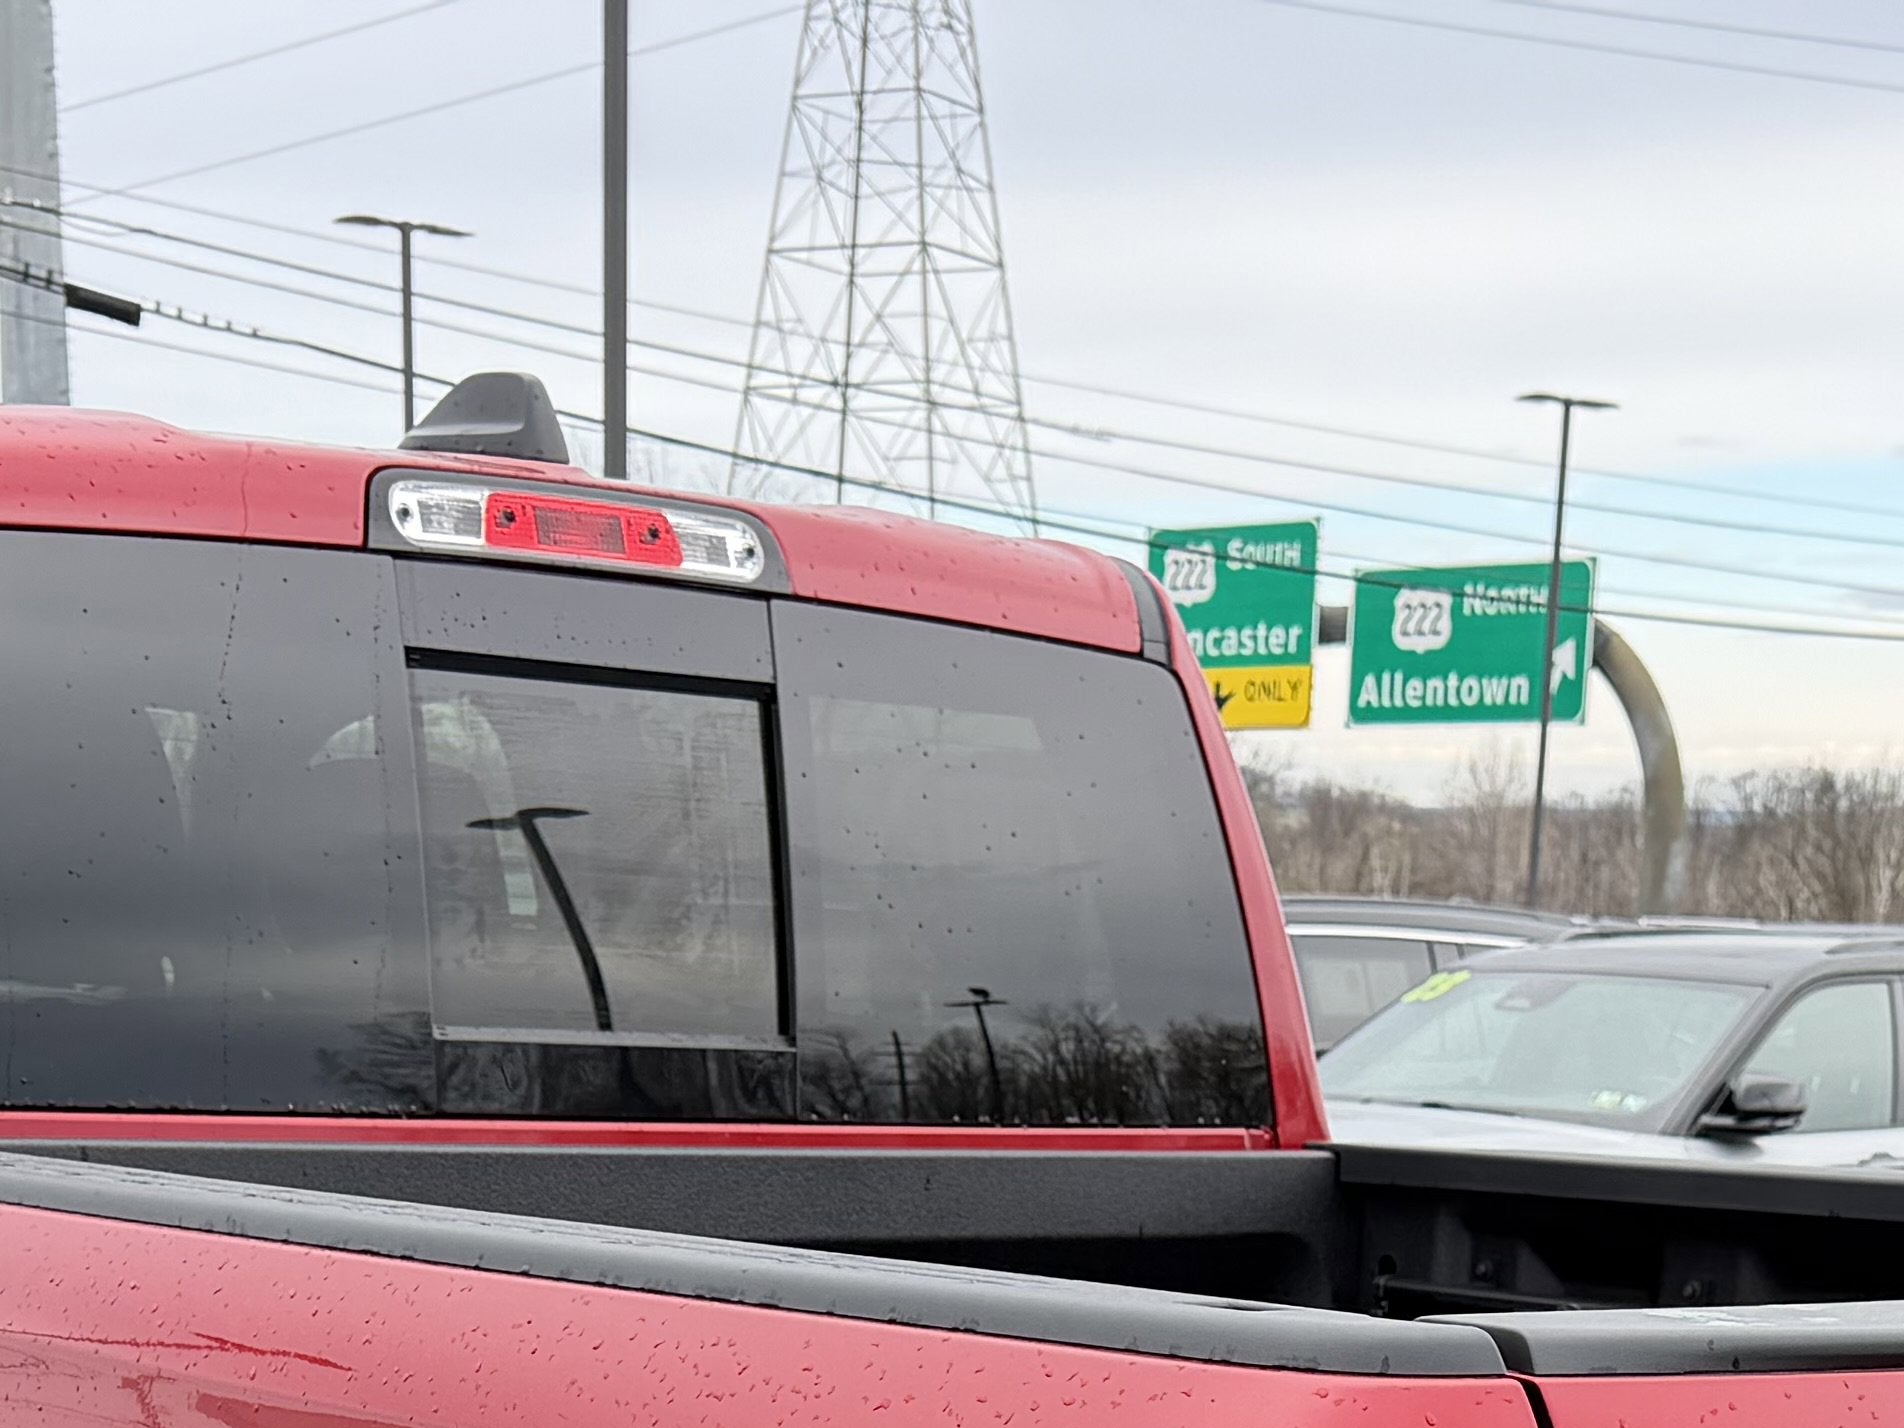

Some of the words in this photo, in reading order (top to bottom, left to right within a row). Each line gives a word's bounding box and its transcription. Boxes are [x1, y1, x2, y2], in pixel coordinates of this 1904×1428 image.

[1169, 558, 1208, 591] 222
[1399, 601, 1444, 637] 222
[1187, 620, 1303, 657] ncaster
[1244, 678, 1303, 703] ONLY
[1357, 668, 1529, 708] Allentown
